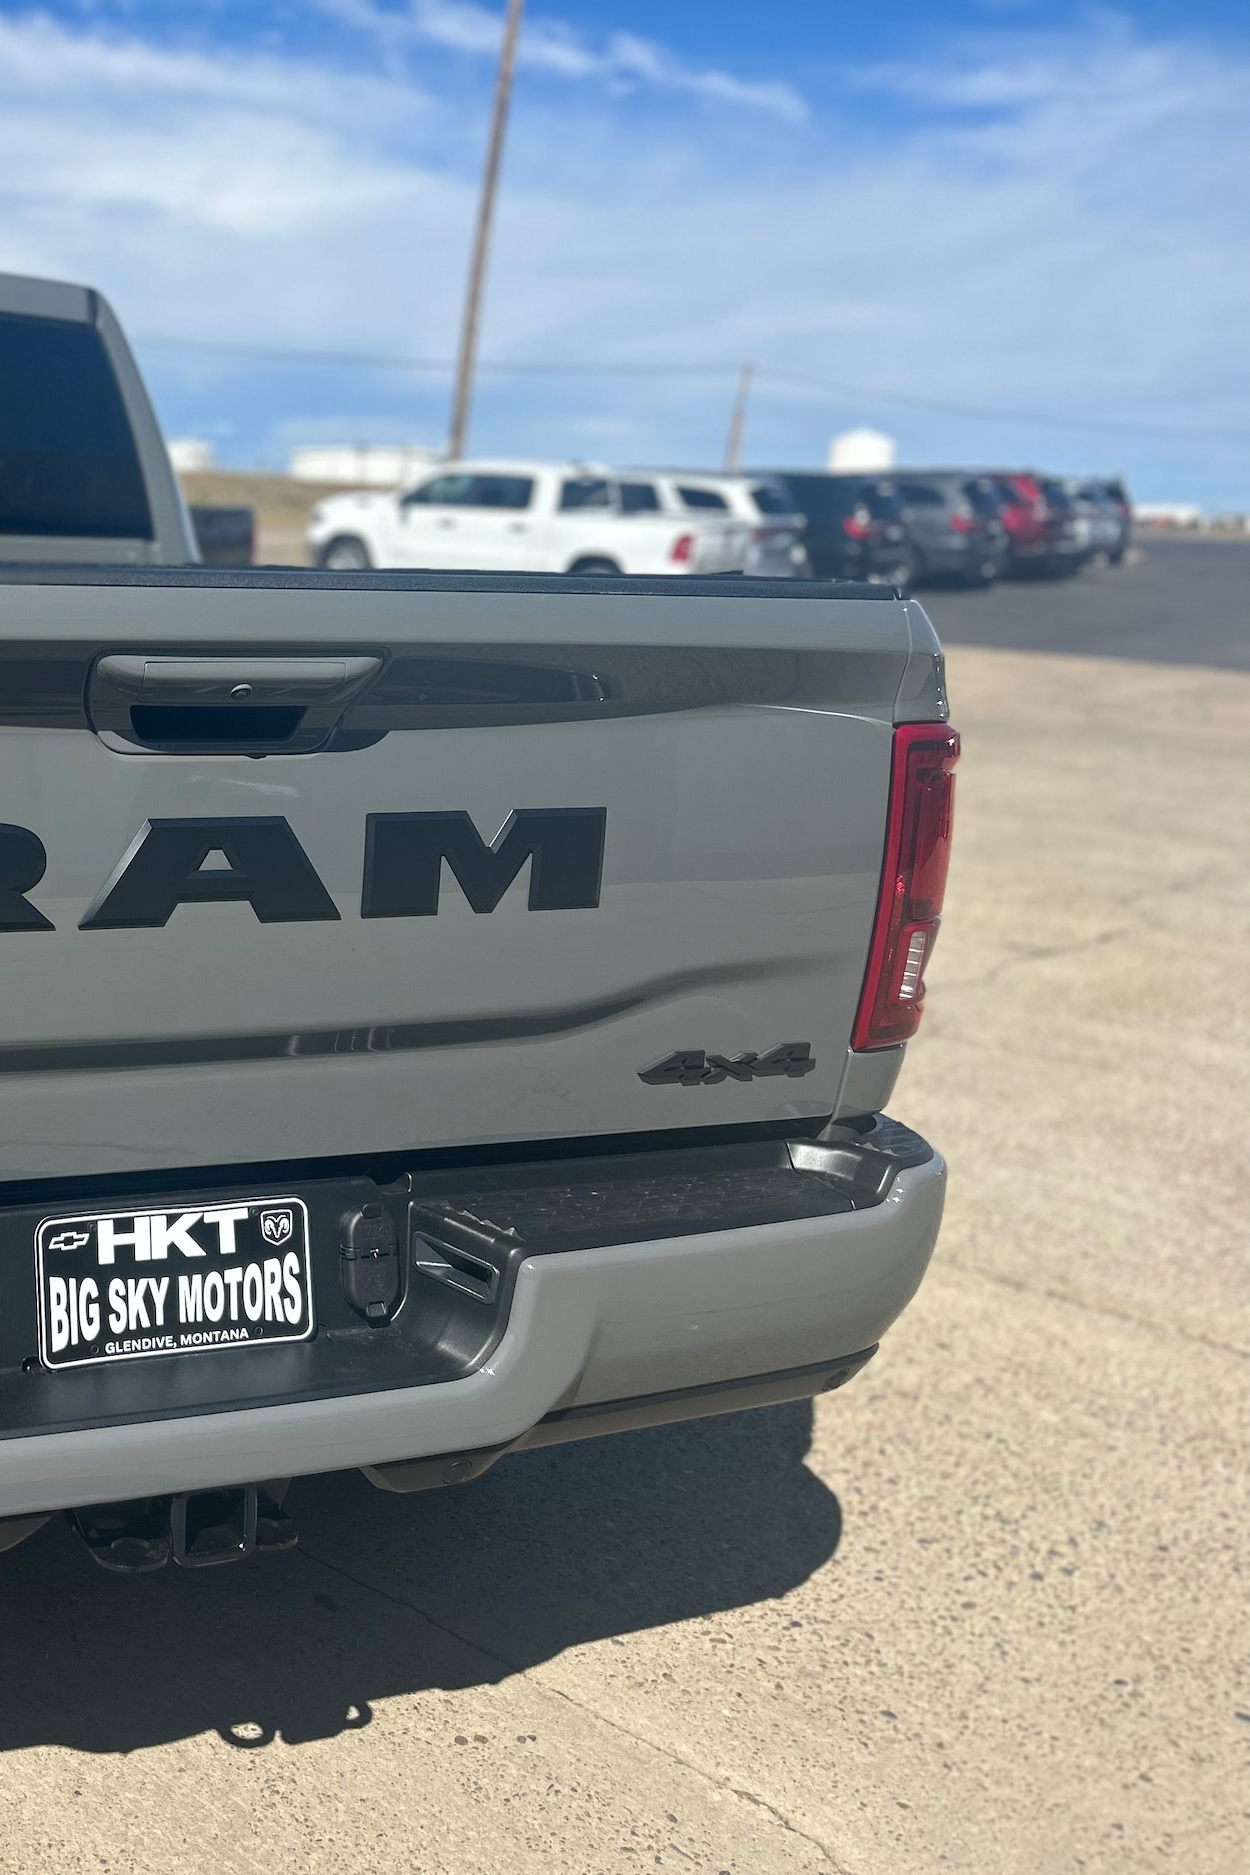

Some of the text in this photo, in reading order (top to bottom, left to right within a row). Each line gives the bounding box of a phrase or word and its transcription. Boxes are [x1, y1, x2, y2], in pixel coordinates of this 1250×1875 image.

[97, 1207, 250, 1265] HKT
[49, 1251, 302, 1353] BIG SKY MOTORS
[105, 1327, 250, 1355] GLENDIVE, MONTANA
